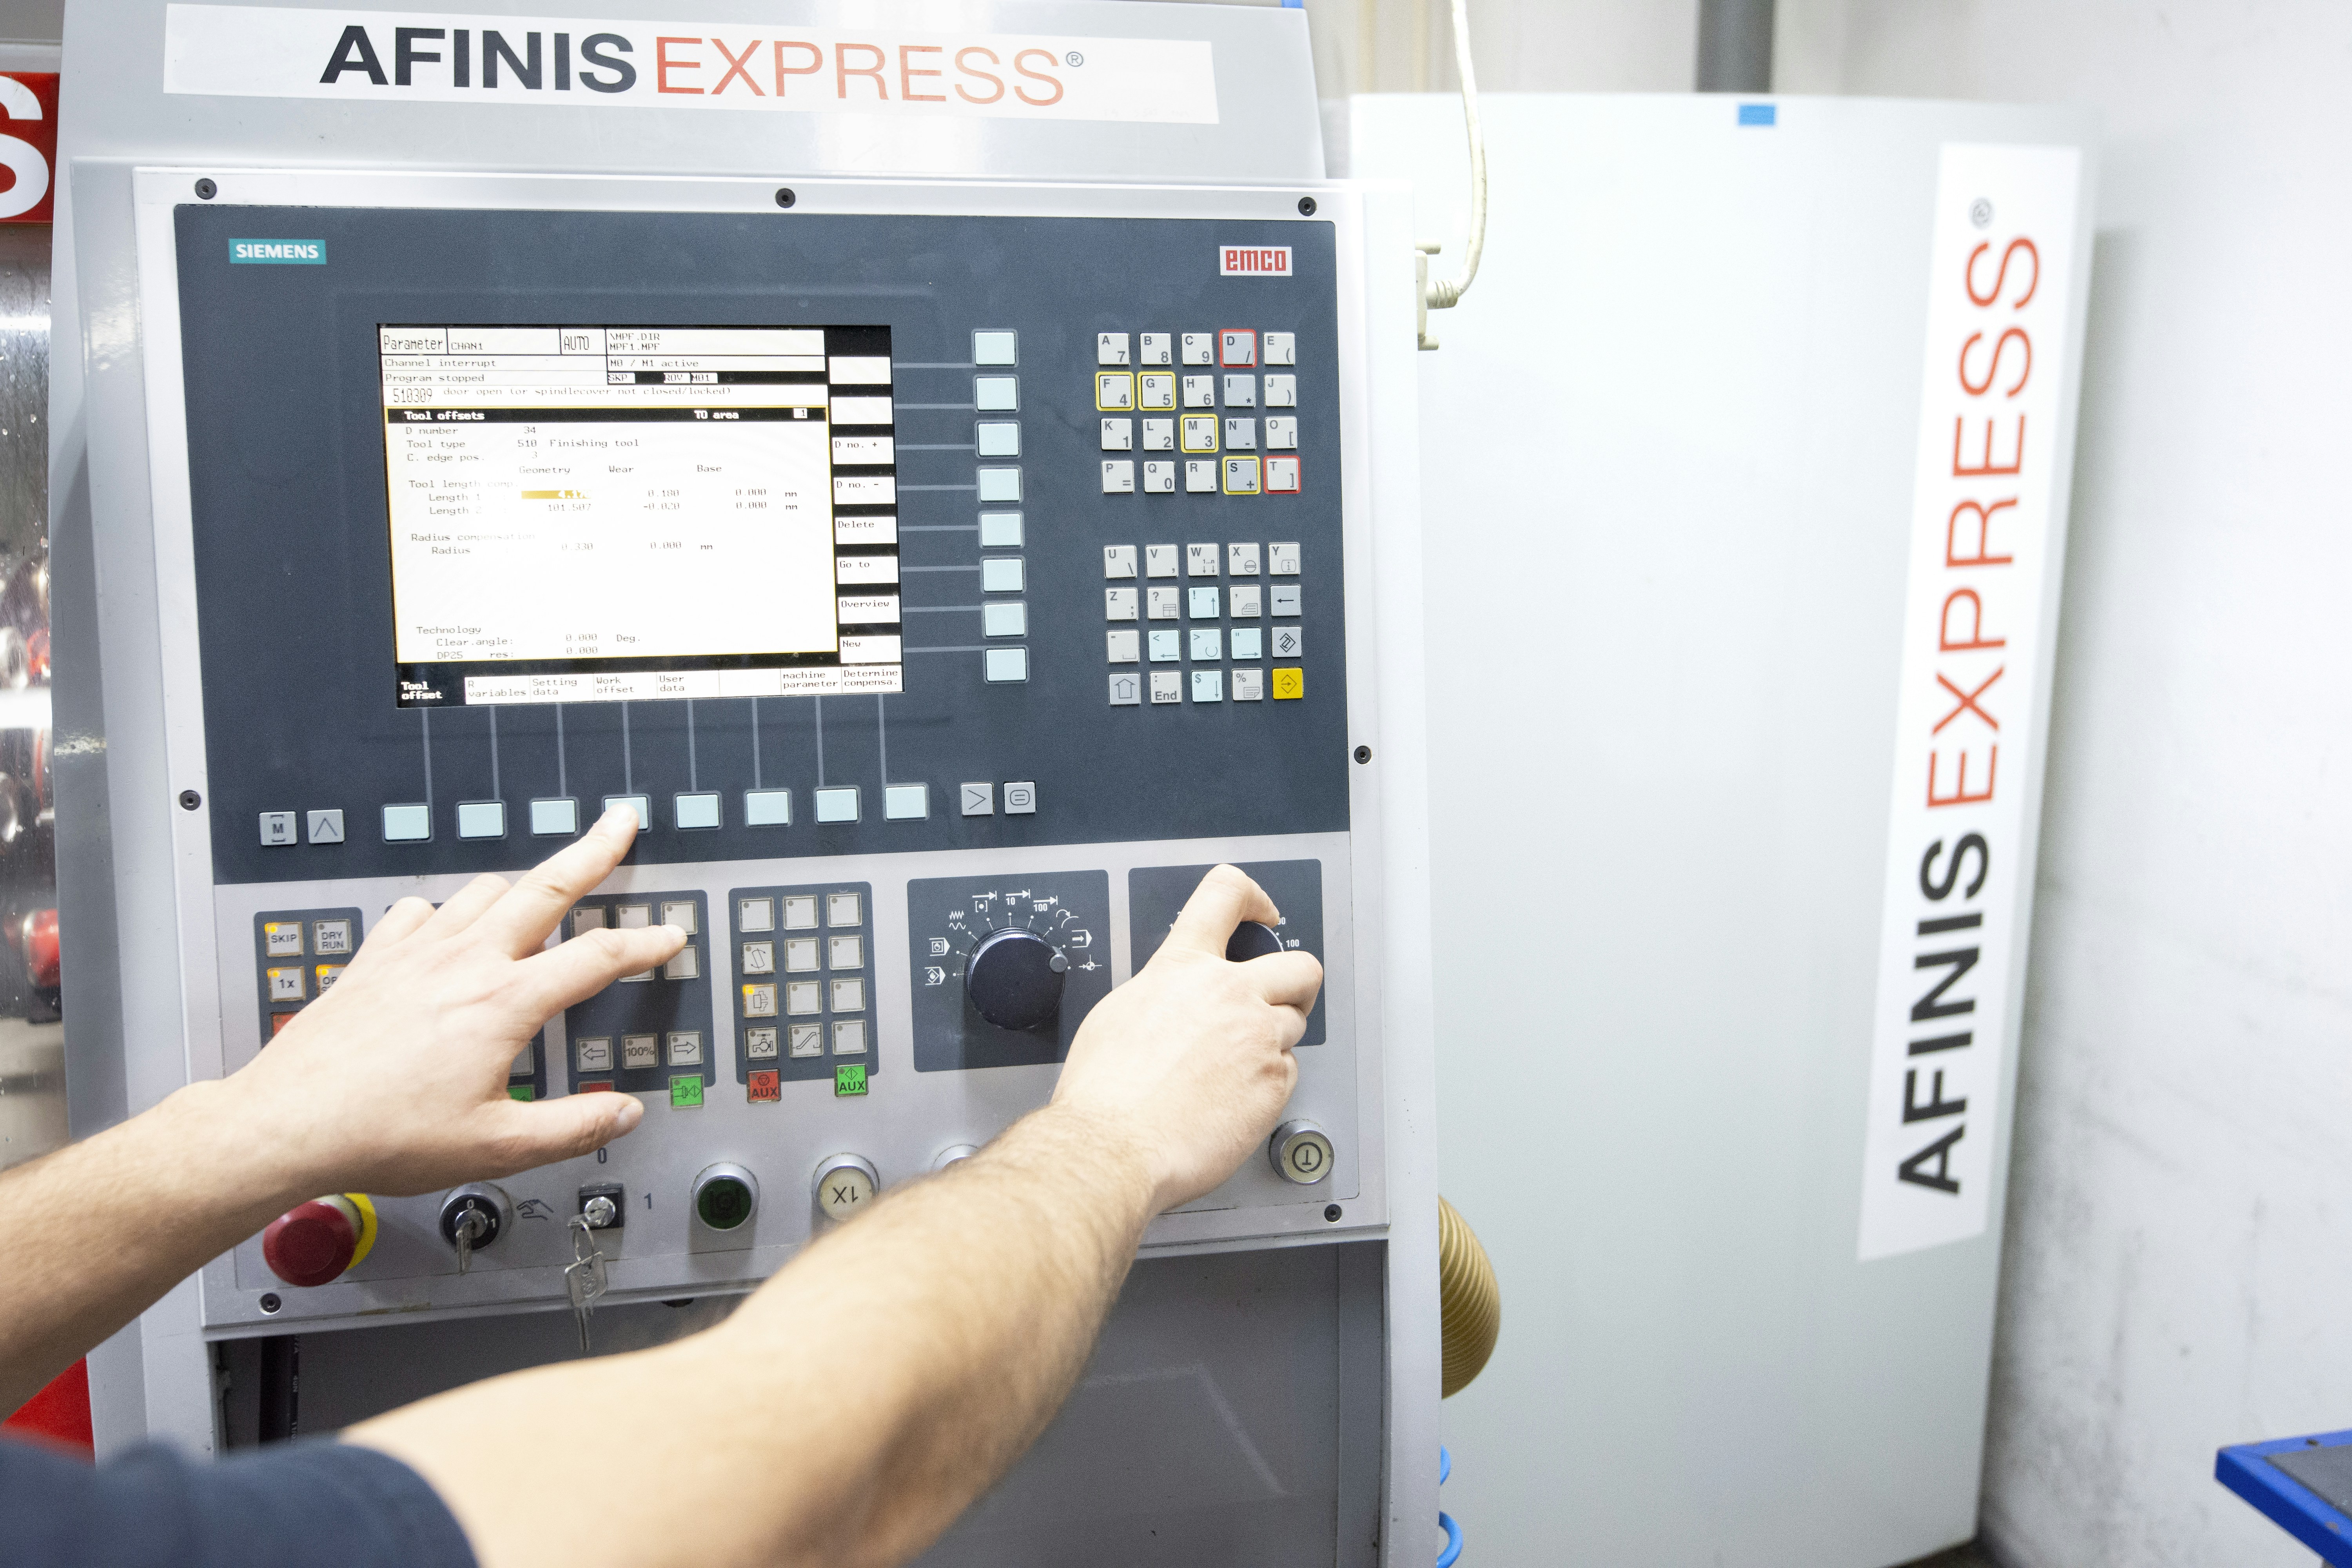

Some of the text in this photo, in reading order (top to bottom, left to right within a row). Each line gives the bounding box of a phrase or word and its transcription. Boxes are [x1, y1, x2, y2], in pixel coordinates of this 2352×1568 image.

[319, 25, 637, 93] AFINIS
[236, 244, 319, 258] SIEMENS
[1226, 250, 1286, 271] emco
[384, 336, 443, 350] Parameter
[564, 336, 589, 350] AUTO
[1102, 336, 1110, 345] A
[1145, 336, 1152, 345] B
[1185, 336, 1193, 345] C
[1227, 337, 1235, 345] D
[1268, 336, 1274, 345] E
[1118, 352, 1125, 362] 7
[1161, 352, 1169, 363] 8
[1202, 352, 1210, 363] 9
[385, 359, 496, 368] Channel interrupt
[386, 374, 485, 383] Program stopped
[1268, 378, 1274, 387] J
[1104, 379, 1110, 388] F
[1146, 379, 1155, 388] G
[1187, 379, 1194, 388] H
[394, 388, 432, 403] 510309
[535, 387, 612, 396] spindlecover
[1120, 394, 1127, 405] 4
[1204, 394, 1211, 405] 6
[1163, 395, 1171, 405] 5
[405, 411, 485, 420] Tool offsets
[713, 411, 739, 419] area
[1105, 422, 1113, 430] K
[1147, 422, 1154, 431] L
[1189, 421, 1197, 430] M
[1229, 421, 1236, 430] N
[441, 441, 465, 449] type
[550, 439, 607, 448] Finishing
[1123, 437, 1129, 447] 1
[1163, 437, 1171, 448] 2
[1205, 436, 1213, 447] 3
[428, 454, 452, 463] edge
[519, 466, 570, 475] Geometry
[1107, 464, 1113, 472] P
[1148, 464, 1156, 474] Q
[1190, 464, 1198, 472] R
[1230, 463, 1238, 472] S
[1270, 462, 1277, 470] T
[443, 480, 481, 489] length
[1164, 479, 1172, 489] 0
[430, 494, 468, 503] Length
[430, 507, 469, 515] Length
[457, 533, 535, 542] compensation
[1109, 550, 1116, 559] U
[1151, 549, 1158, 558] V
[1191, 548, 1201, 556] W
[1233, 547, 1240, 556] X
[1272, 546, 1279, 555] Y
[1110, 592, 1117, 601] Z
[417, 626, 481, 635] Technology
[437, 633, 640, 647] Clear.angle: 0.000 Deg.
[844, 669, 898, 677] Determine
[401, 682, 429, 691] Tool
[533, 678, 577, 687] Setting
[402, 691, 443, 700] offset
[468, 689, 526, 697] variables
[1156, 691, 1177, 701] End
[272, 824, 283, 833] M
[1006, 897, 1015, 906] 10
[1034, 903, 1048, 911] 100
[271, 934, 297, 943] SKIP
[322, 932, 343, 940] DRY
[322, 941, 344, 949] RUN
[1286, 939, 1299, 947] 100
[279, 979, 294, 989] 1x
[323, 976, 338, 985] OP
[1897, 829, 1991, 1195] AFINIS
[626, 1046, 655, 1057] 100%
[839, 1080, 865, 1091] AUX
[751, 1087, 778, 1098] AUX
[597, 1147, 607, 1164] 0
[466, 1199, 474, 1209] 0
[644, 1193, 652, 1209] 1
[491, 1218, 496, 1229] 1
